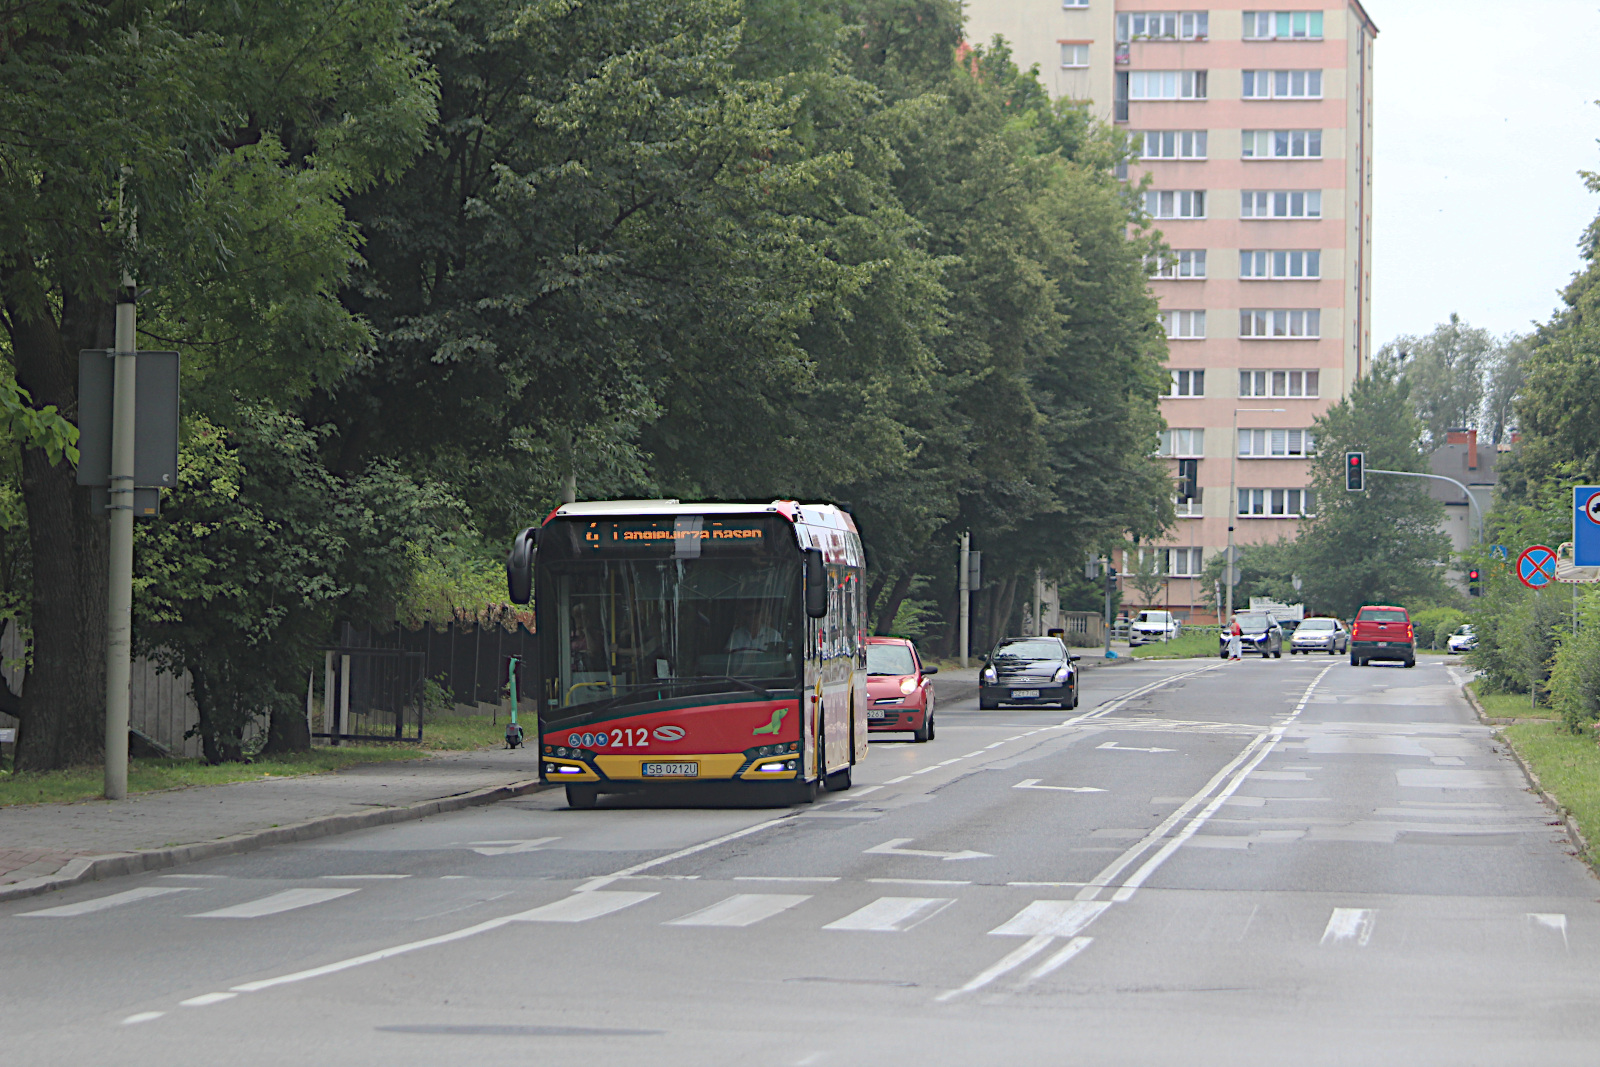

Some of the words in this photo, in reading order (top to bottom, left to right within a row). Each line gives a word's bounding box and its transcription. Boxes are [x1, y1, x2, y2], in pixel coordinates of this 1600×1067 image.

[610, 728, 649, 747] 212
[648, 764, 663, 774] SB
[665, 764, 696, 774] 0212U
